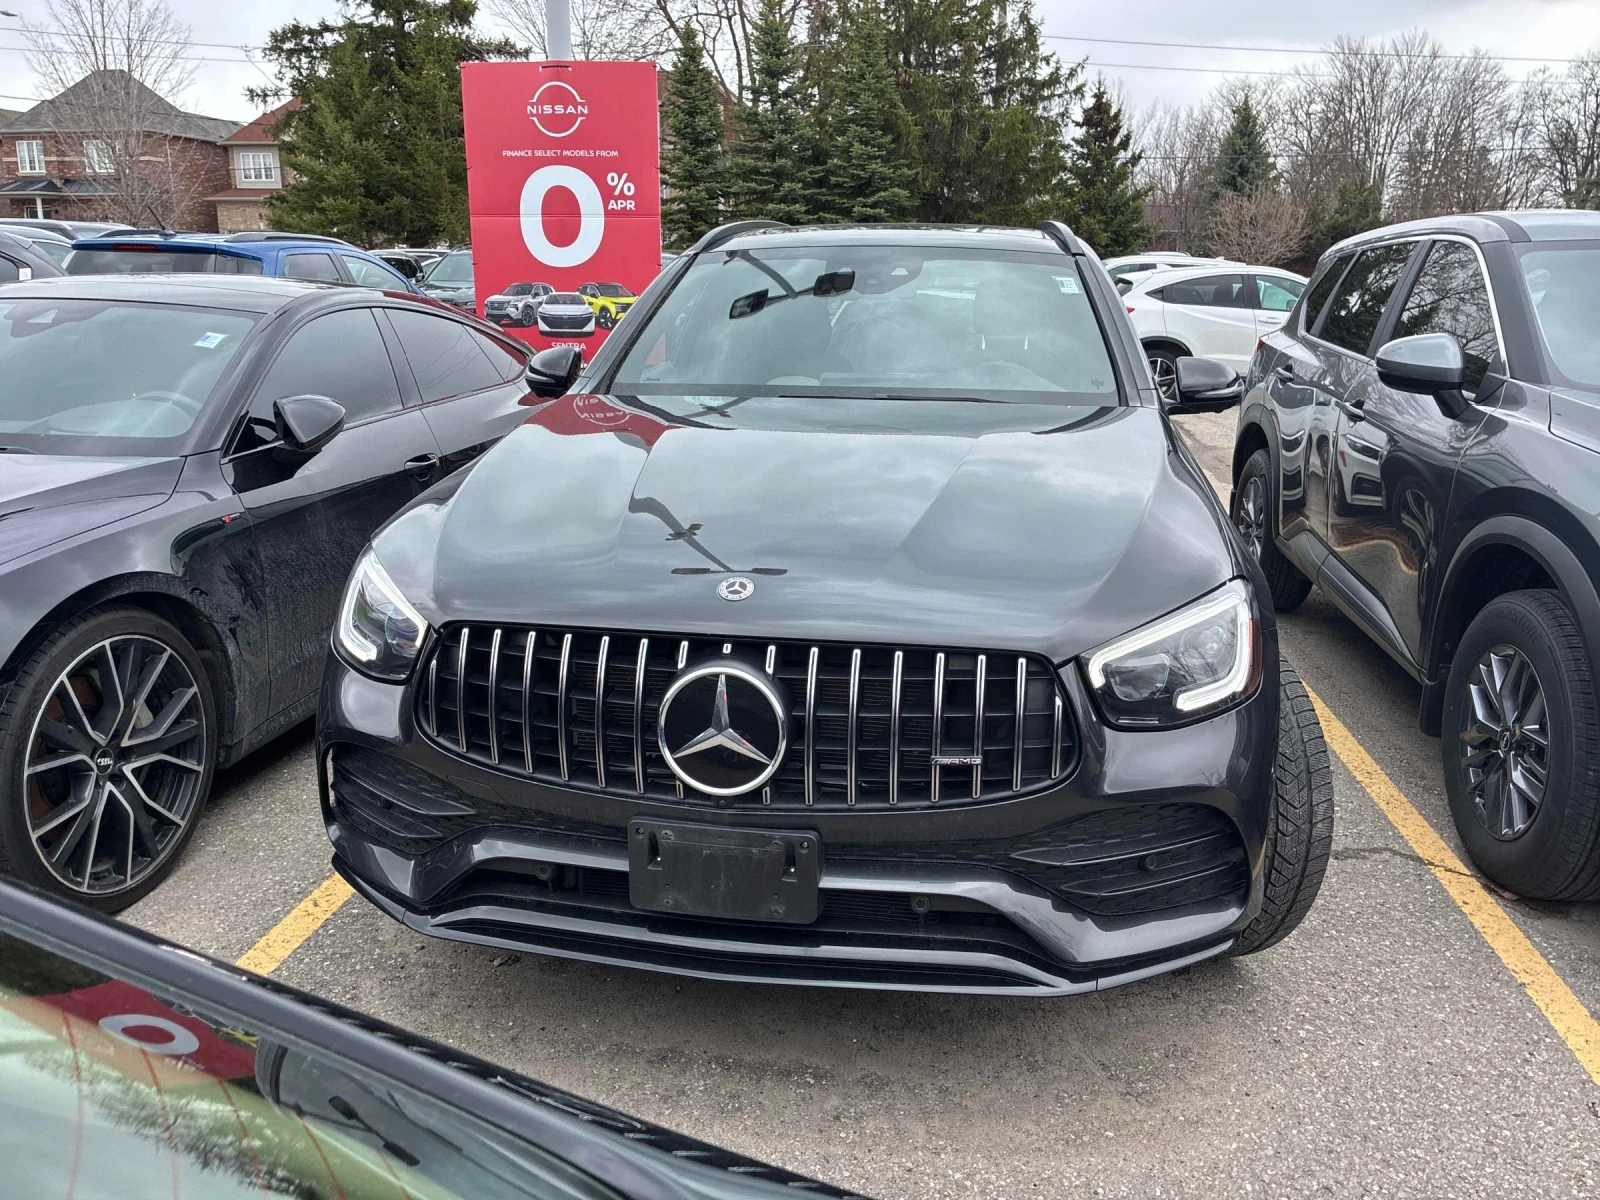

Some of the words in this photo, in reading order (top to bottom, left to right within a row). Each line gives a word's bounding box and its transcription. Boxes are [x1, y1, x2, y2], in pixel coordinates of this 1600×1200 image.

[527, 105, 588, 115] NISSAN
[502, 149, 533, 157] FINANCE
[534, 149, 561, 157] SELECT
[562, 149, 595, 157] MODELS
[595, 149, 619, 157] FROM
[607, 199, 636, 211] APR
[519, 164, 605, 268] 0
[606, 171, 635, 196] %
